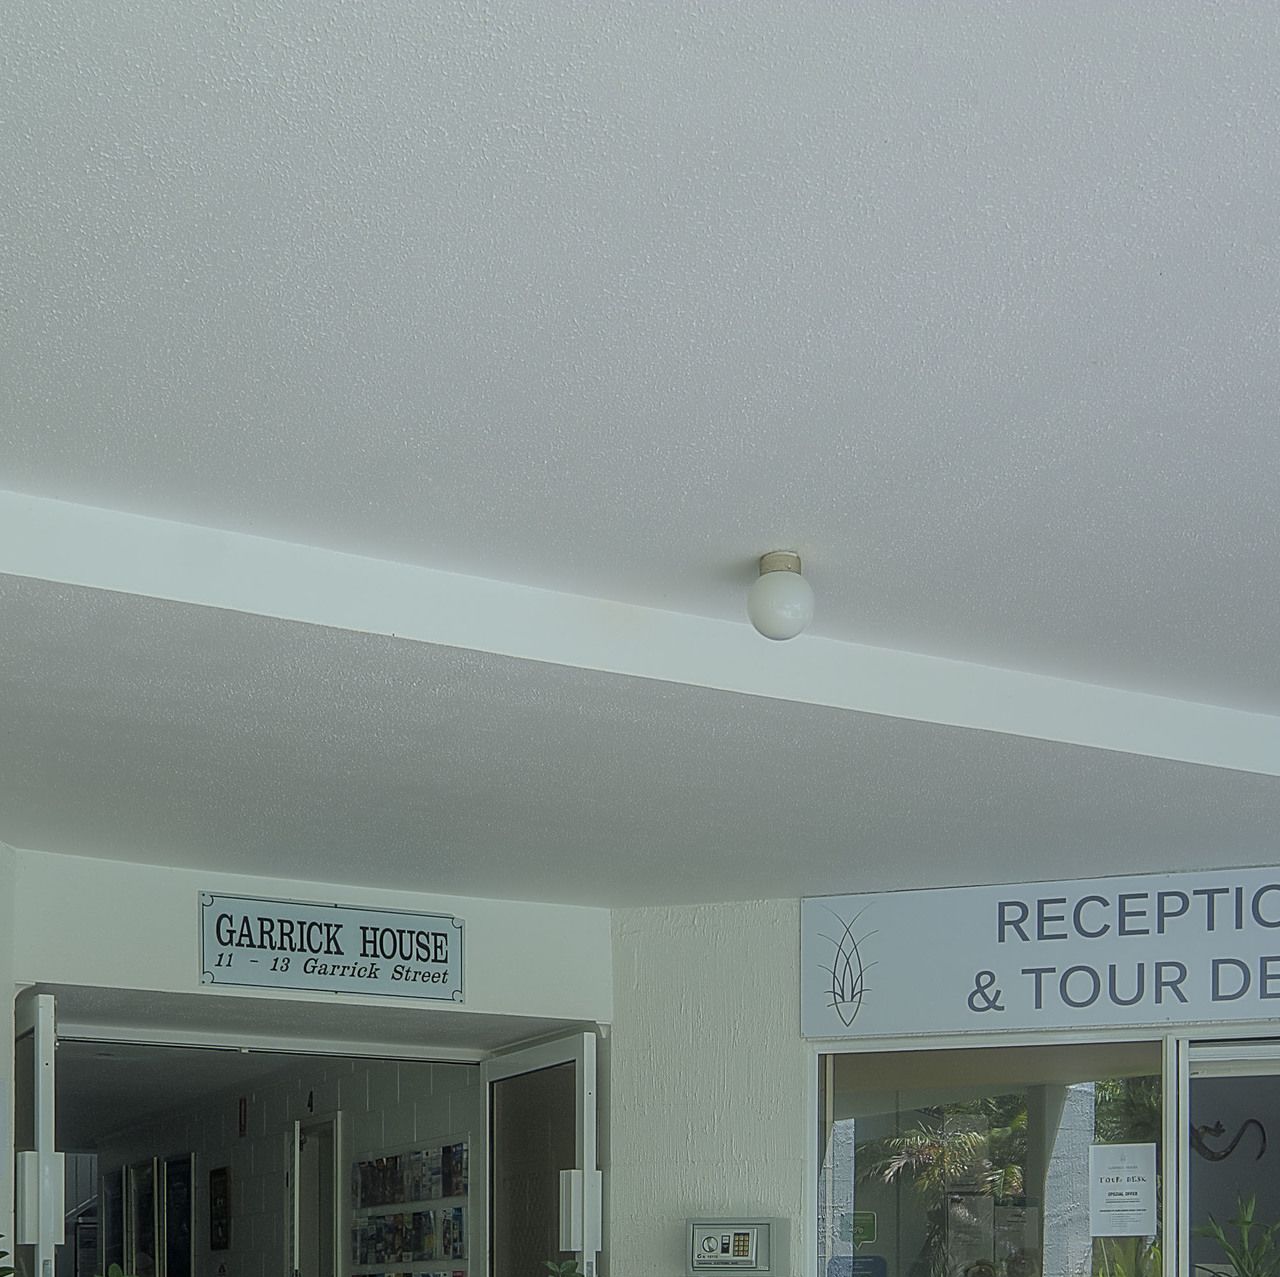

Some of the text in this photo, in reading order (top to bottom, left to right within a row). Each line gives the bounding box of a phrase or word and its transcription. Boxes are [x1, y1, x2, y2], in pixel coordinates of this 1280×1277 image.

[216, 913, 448, 964] GARRICK HOUSE
[215, 952, 234, 968] 11
[270, 956, 291, 972] 13
[303, 957, 380, 980] Garrick
[391, 964, 450, 984] Street
[966, 970, 1006, 1013] &
[1021, 962, 1189, 1011] TOUR
